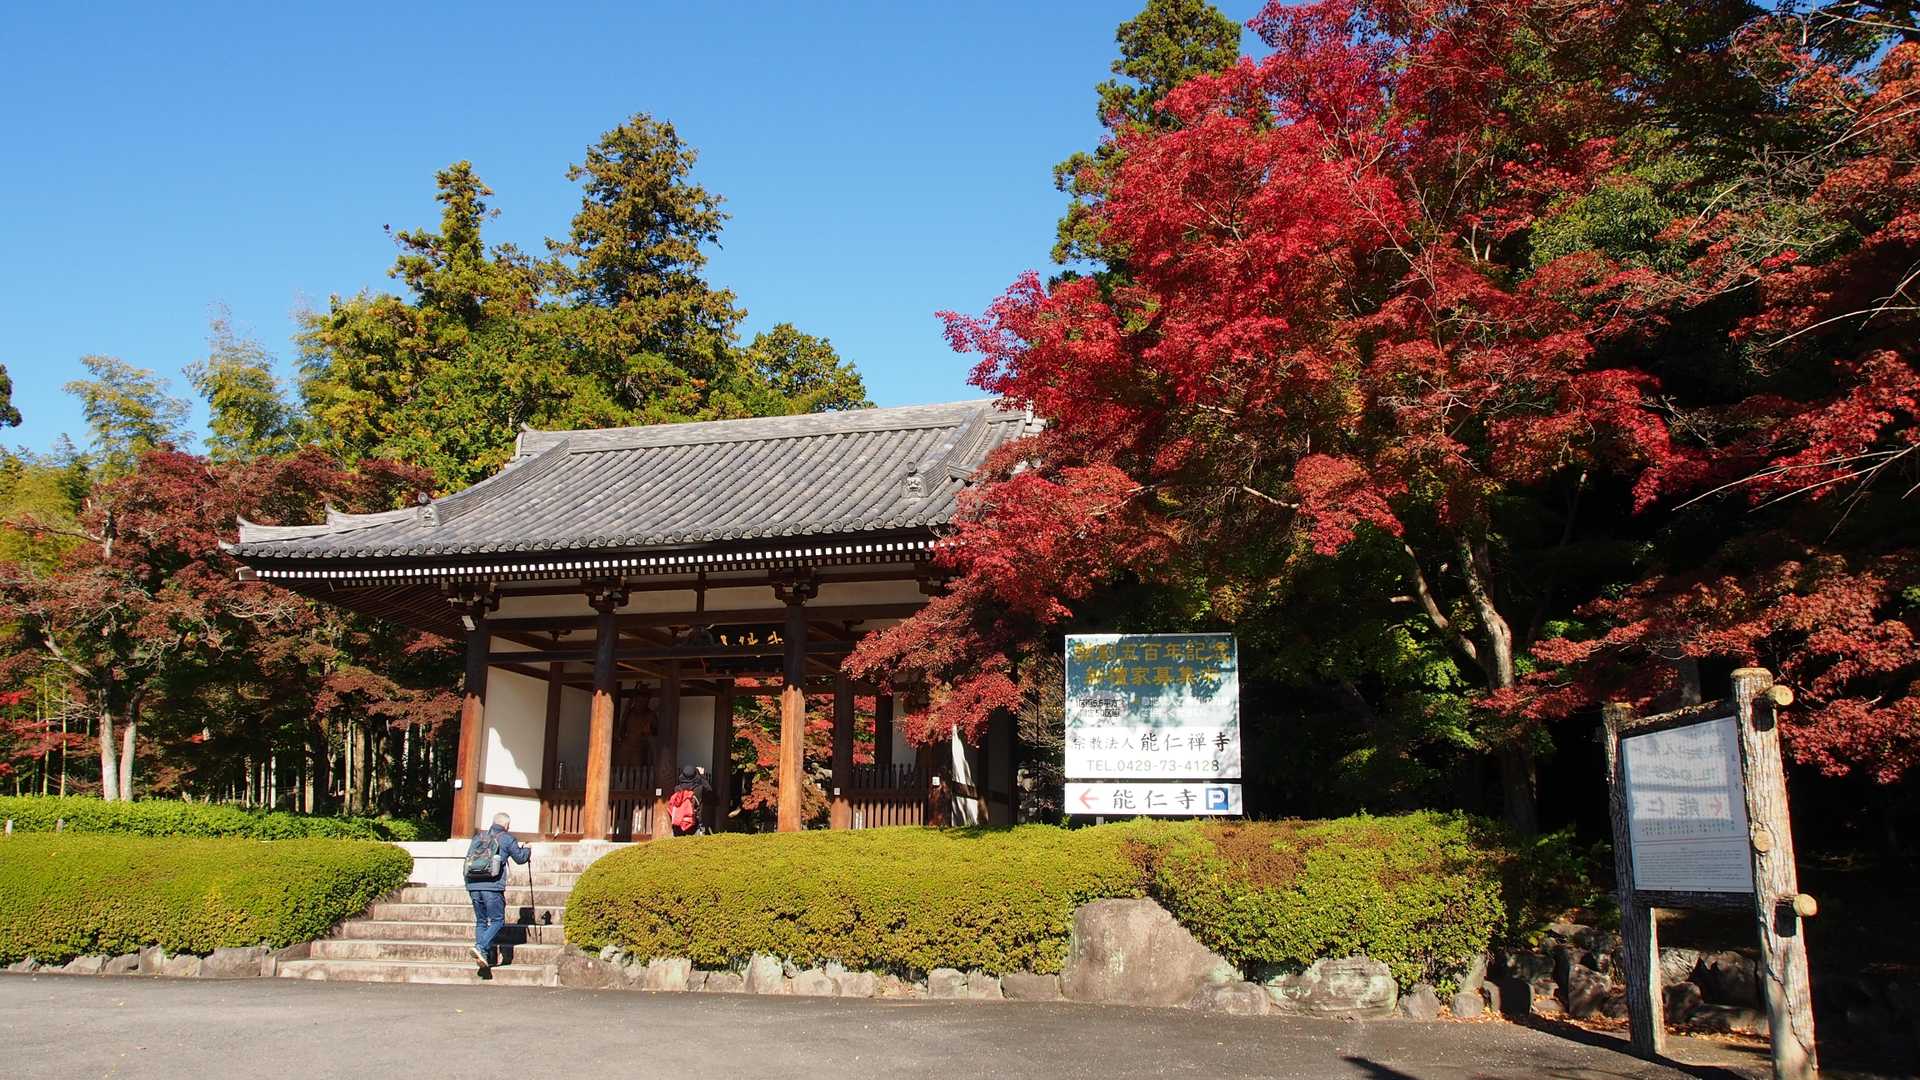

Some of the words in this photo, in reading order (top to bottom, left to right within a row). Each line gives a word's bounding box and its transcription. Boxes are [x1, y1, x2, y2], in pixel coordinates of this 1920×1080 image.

[1113, 789, 1197, 810] 能仁寺
[1207, 789, 1226, 810] P
